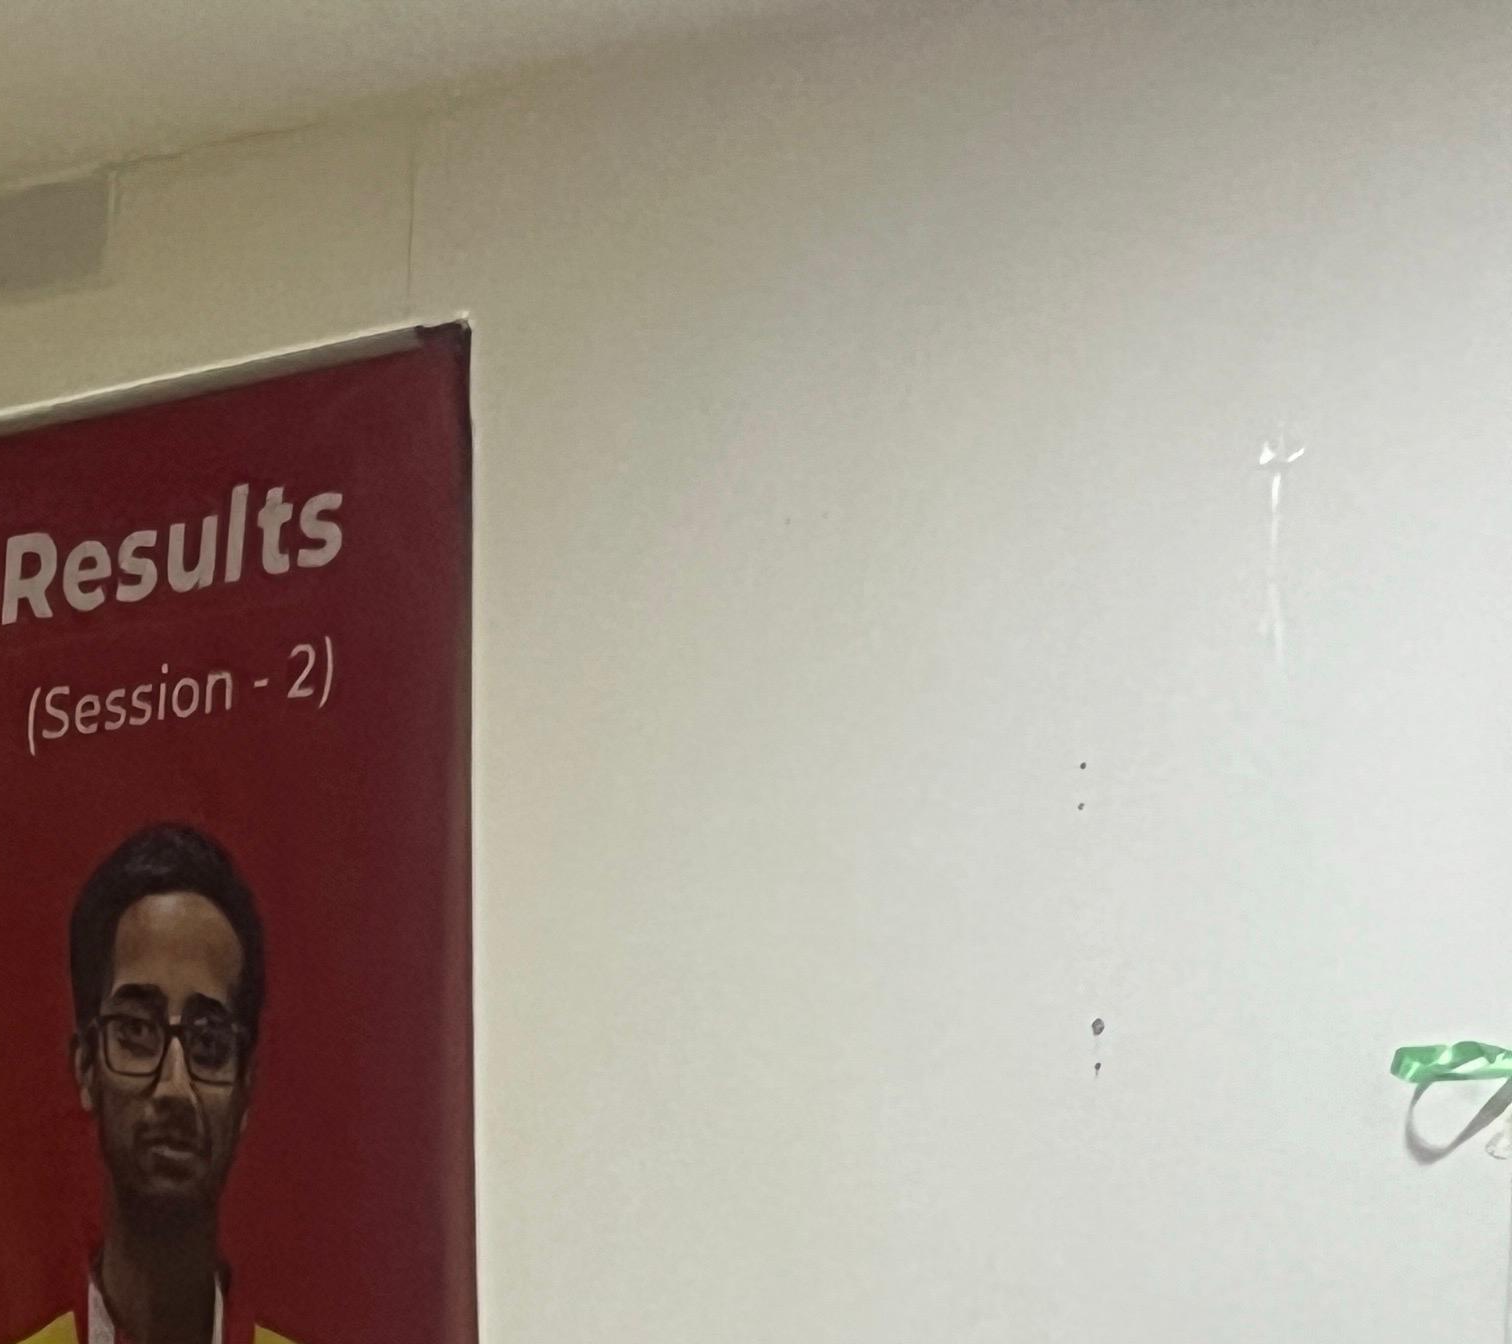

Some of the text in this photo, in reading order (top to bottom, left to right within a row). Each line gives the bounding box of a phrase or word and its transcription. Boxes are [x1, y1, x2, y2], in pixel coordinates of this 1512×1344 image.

[0, 482, 345, 627] Results
[27, 658, 235, 756] (Session
[286, 636, 334, 709] 2)
